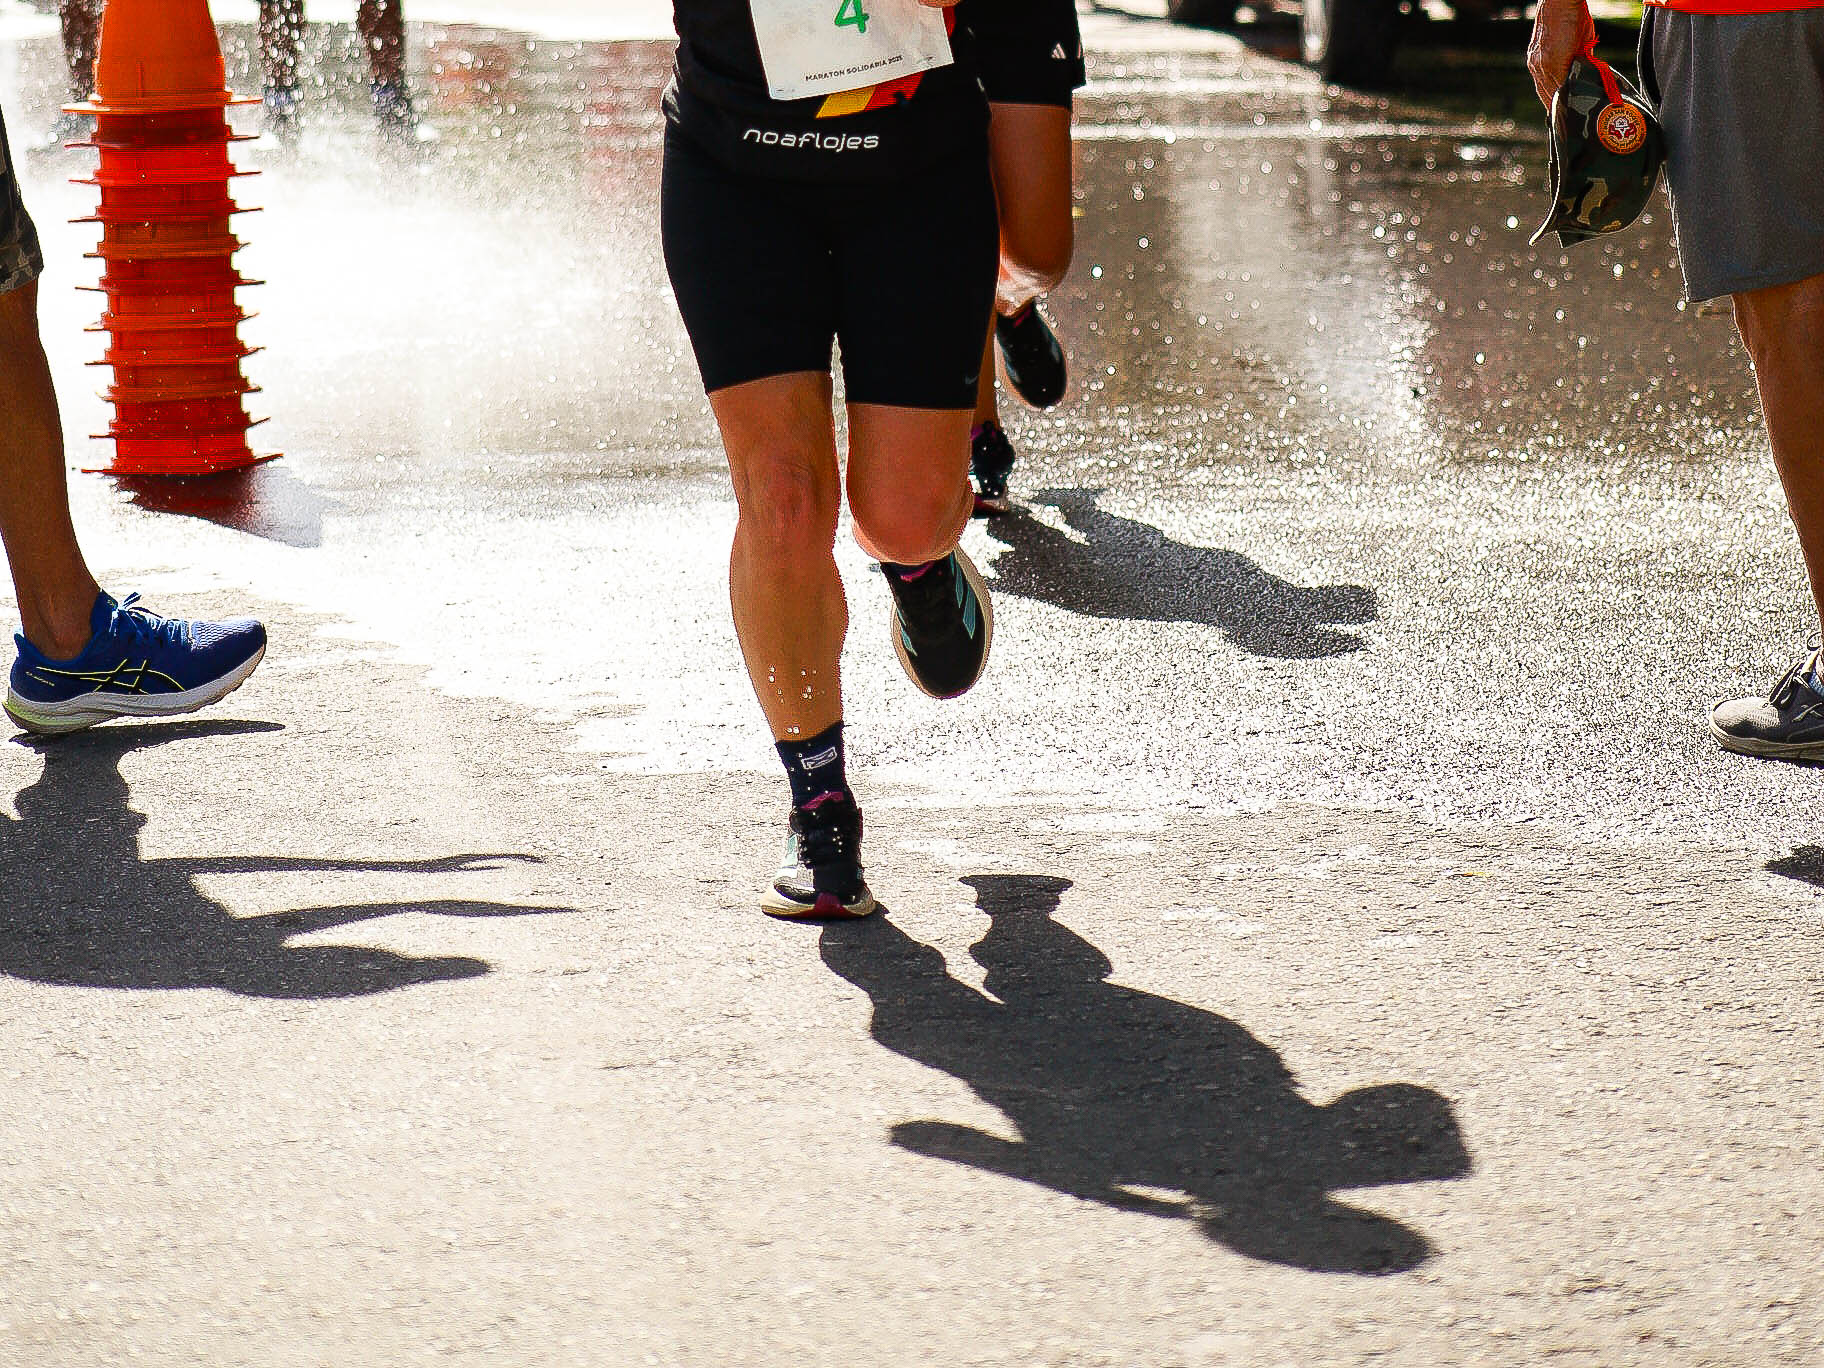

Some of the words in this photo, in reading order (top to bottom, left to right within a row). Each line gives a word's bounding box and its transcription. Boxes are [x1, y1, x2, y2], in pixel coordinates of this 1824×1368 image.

[805, 69, 846, 82] MARATON
[846, 59, 888, 75] SOLIDARIA
[743, 128, 880, 153] noaflojes
